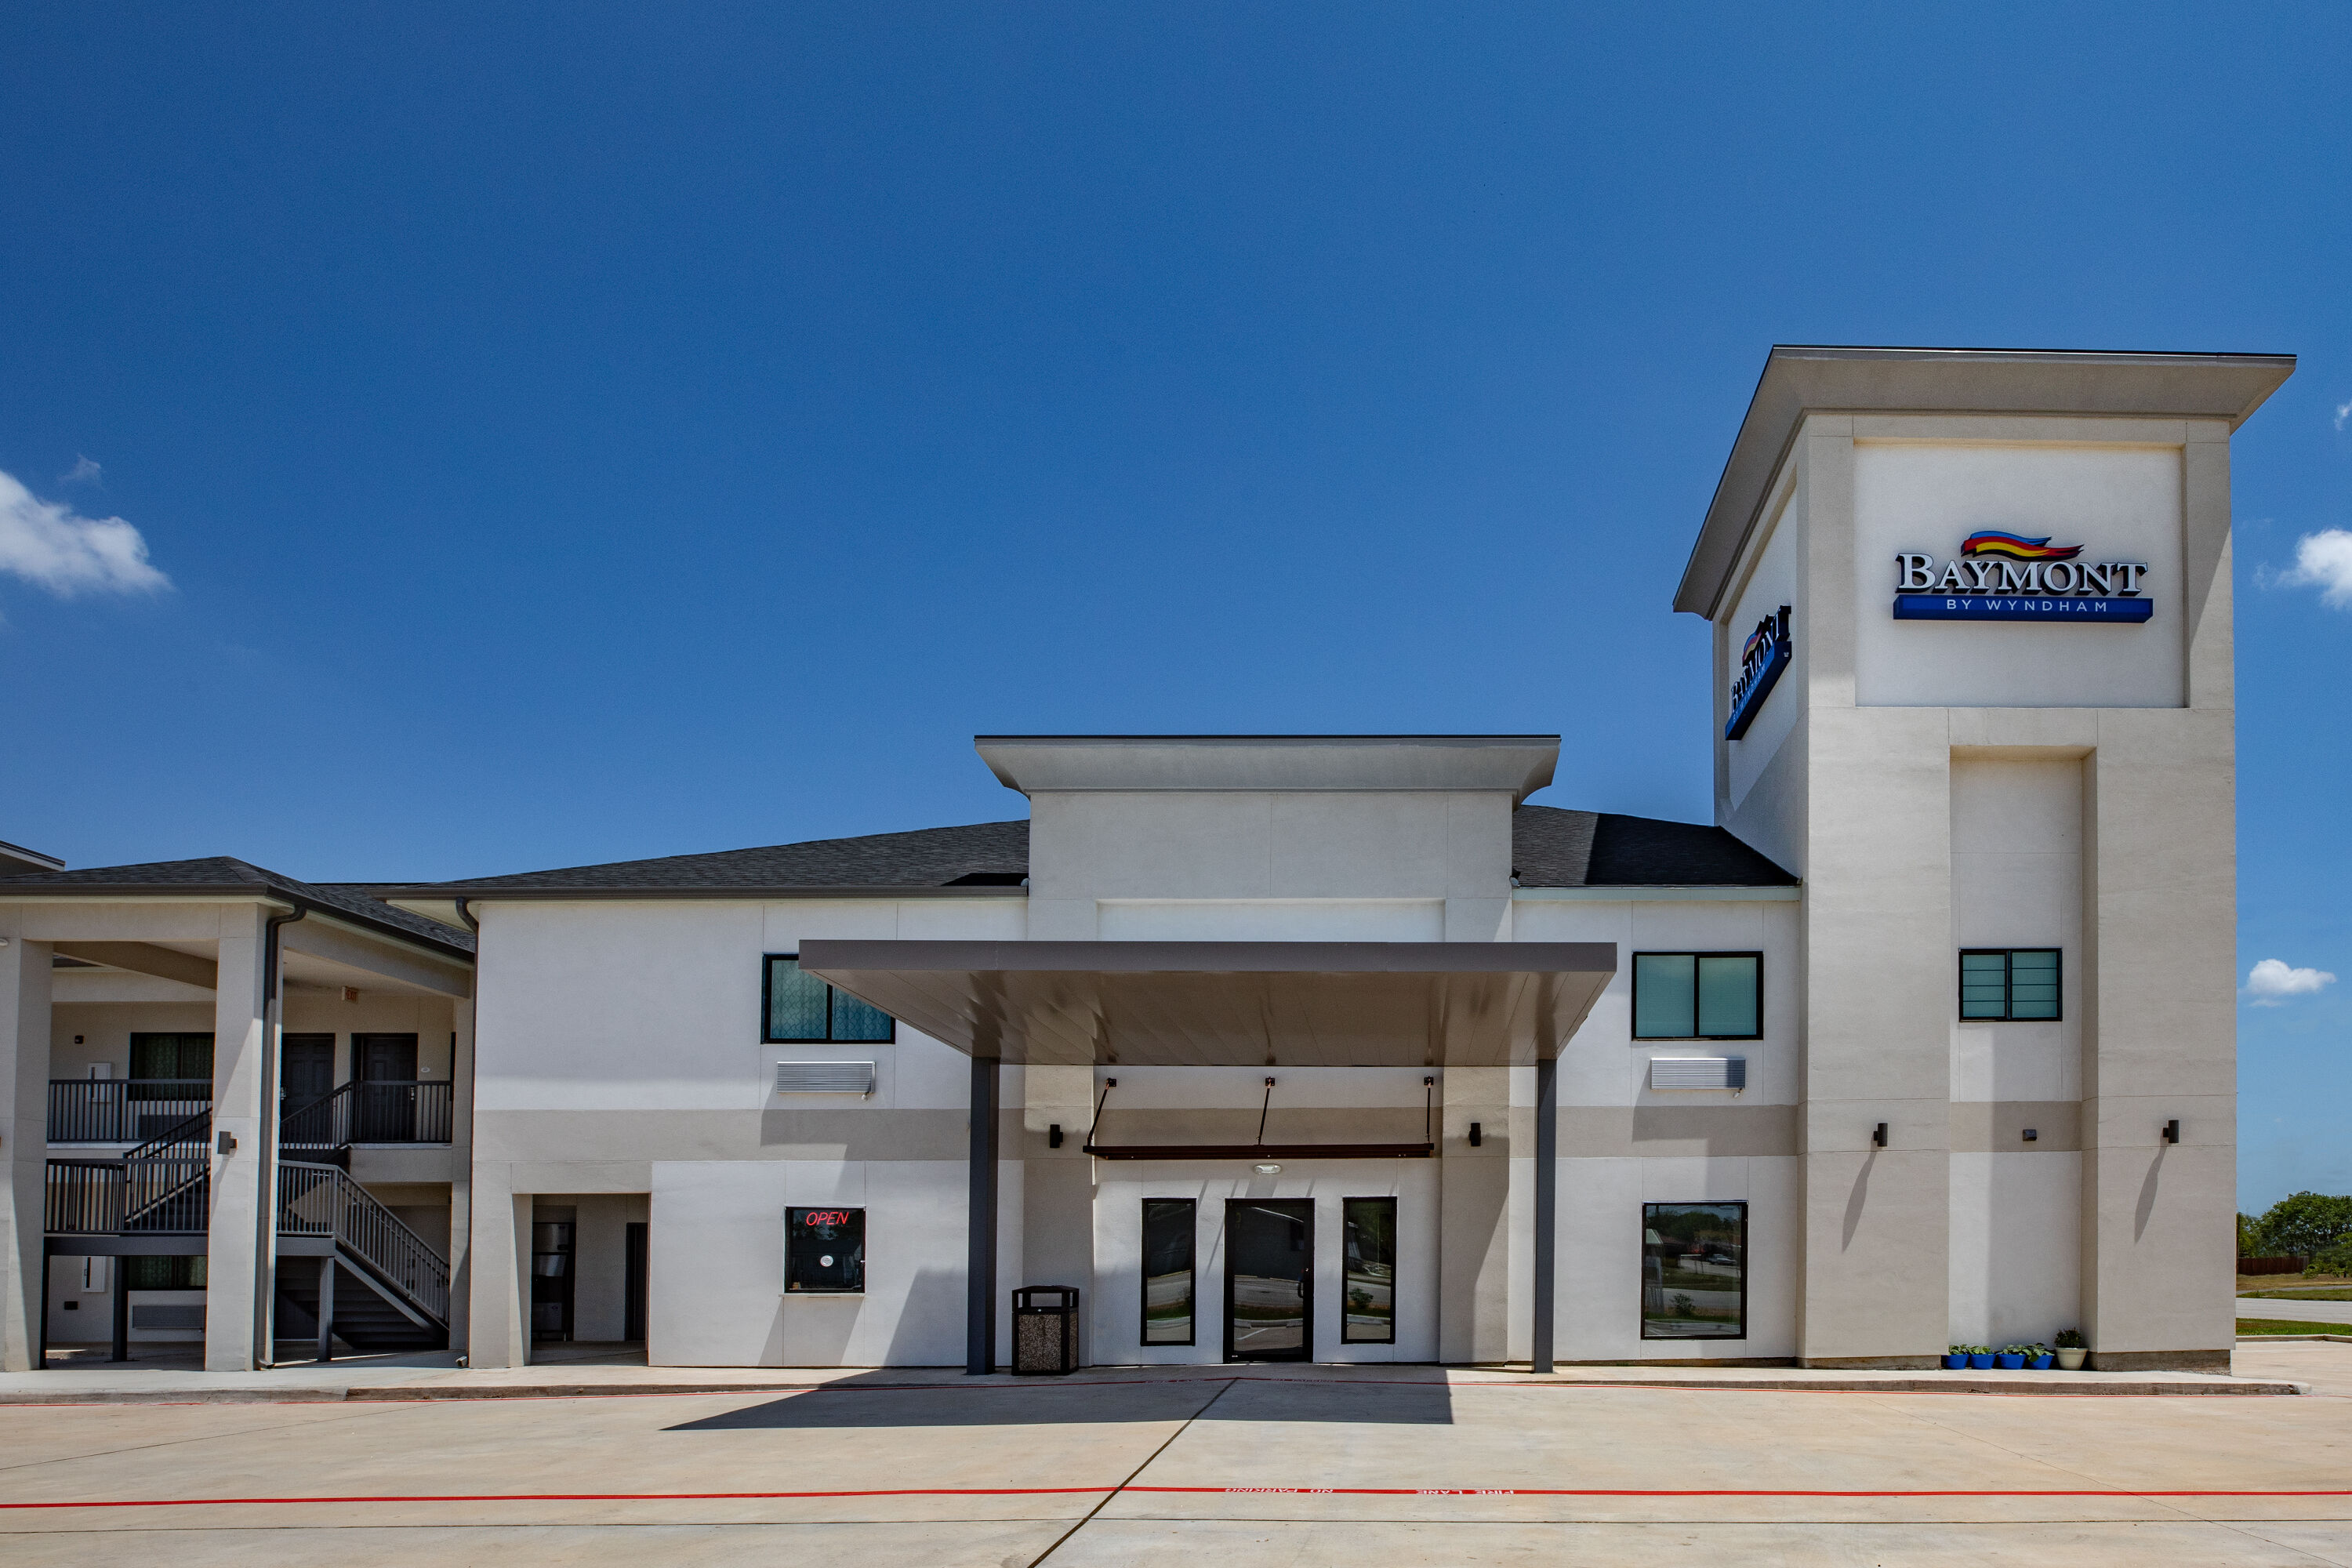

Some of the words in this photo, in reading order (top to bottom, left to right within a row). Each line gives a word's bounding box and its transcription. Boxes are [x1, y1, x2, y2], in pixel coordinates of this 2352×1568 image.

[1896, 554, 2148, 596] BAYMONT
[1947, 599, 1973, 610] BY
[1986, 600, 2107, 612] WYNDHAM
[806, 1211, 849, 1226] OPEN
